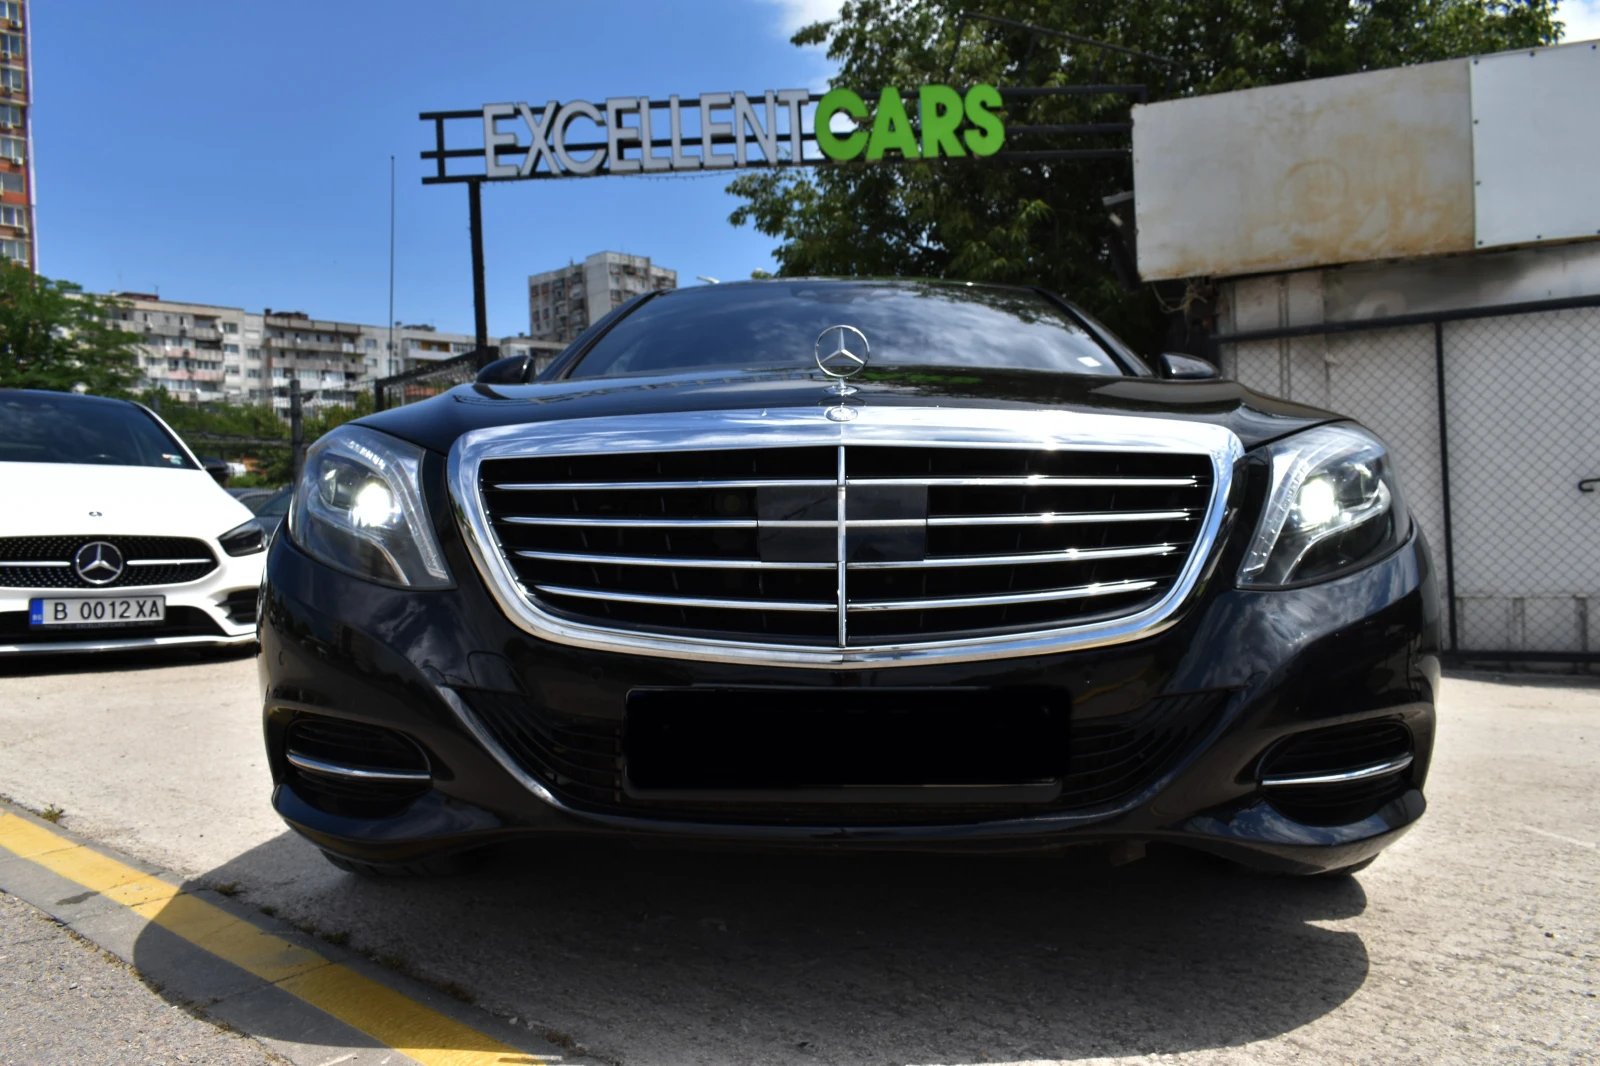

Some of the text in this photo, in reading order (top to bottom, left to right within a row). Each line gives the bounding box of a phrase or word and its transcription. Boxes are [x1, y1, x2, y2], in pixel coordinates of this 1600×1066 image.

[482, 83, 1005, 179] EXCELLENT CARS
[54, 600, 160, 621] B 0012 XA
